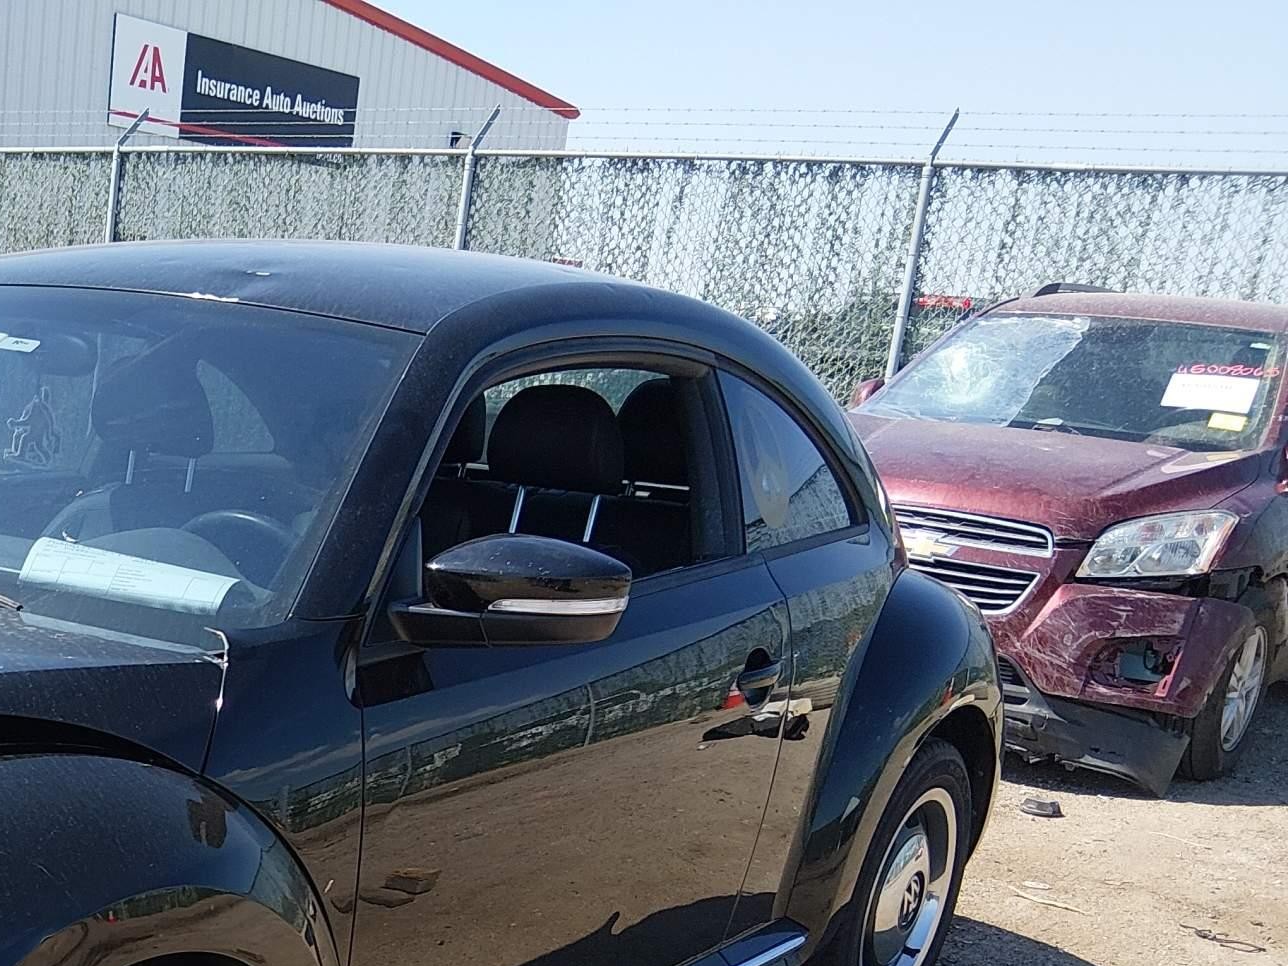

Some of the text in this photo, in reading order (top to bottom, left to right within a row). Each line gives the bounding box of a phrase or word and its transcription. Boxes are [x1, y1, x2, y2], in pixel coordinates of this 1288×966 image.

[196, 70, 344, 126] Insurance Auto Auctions
